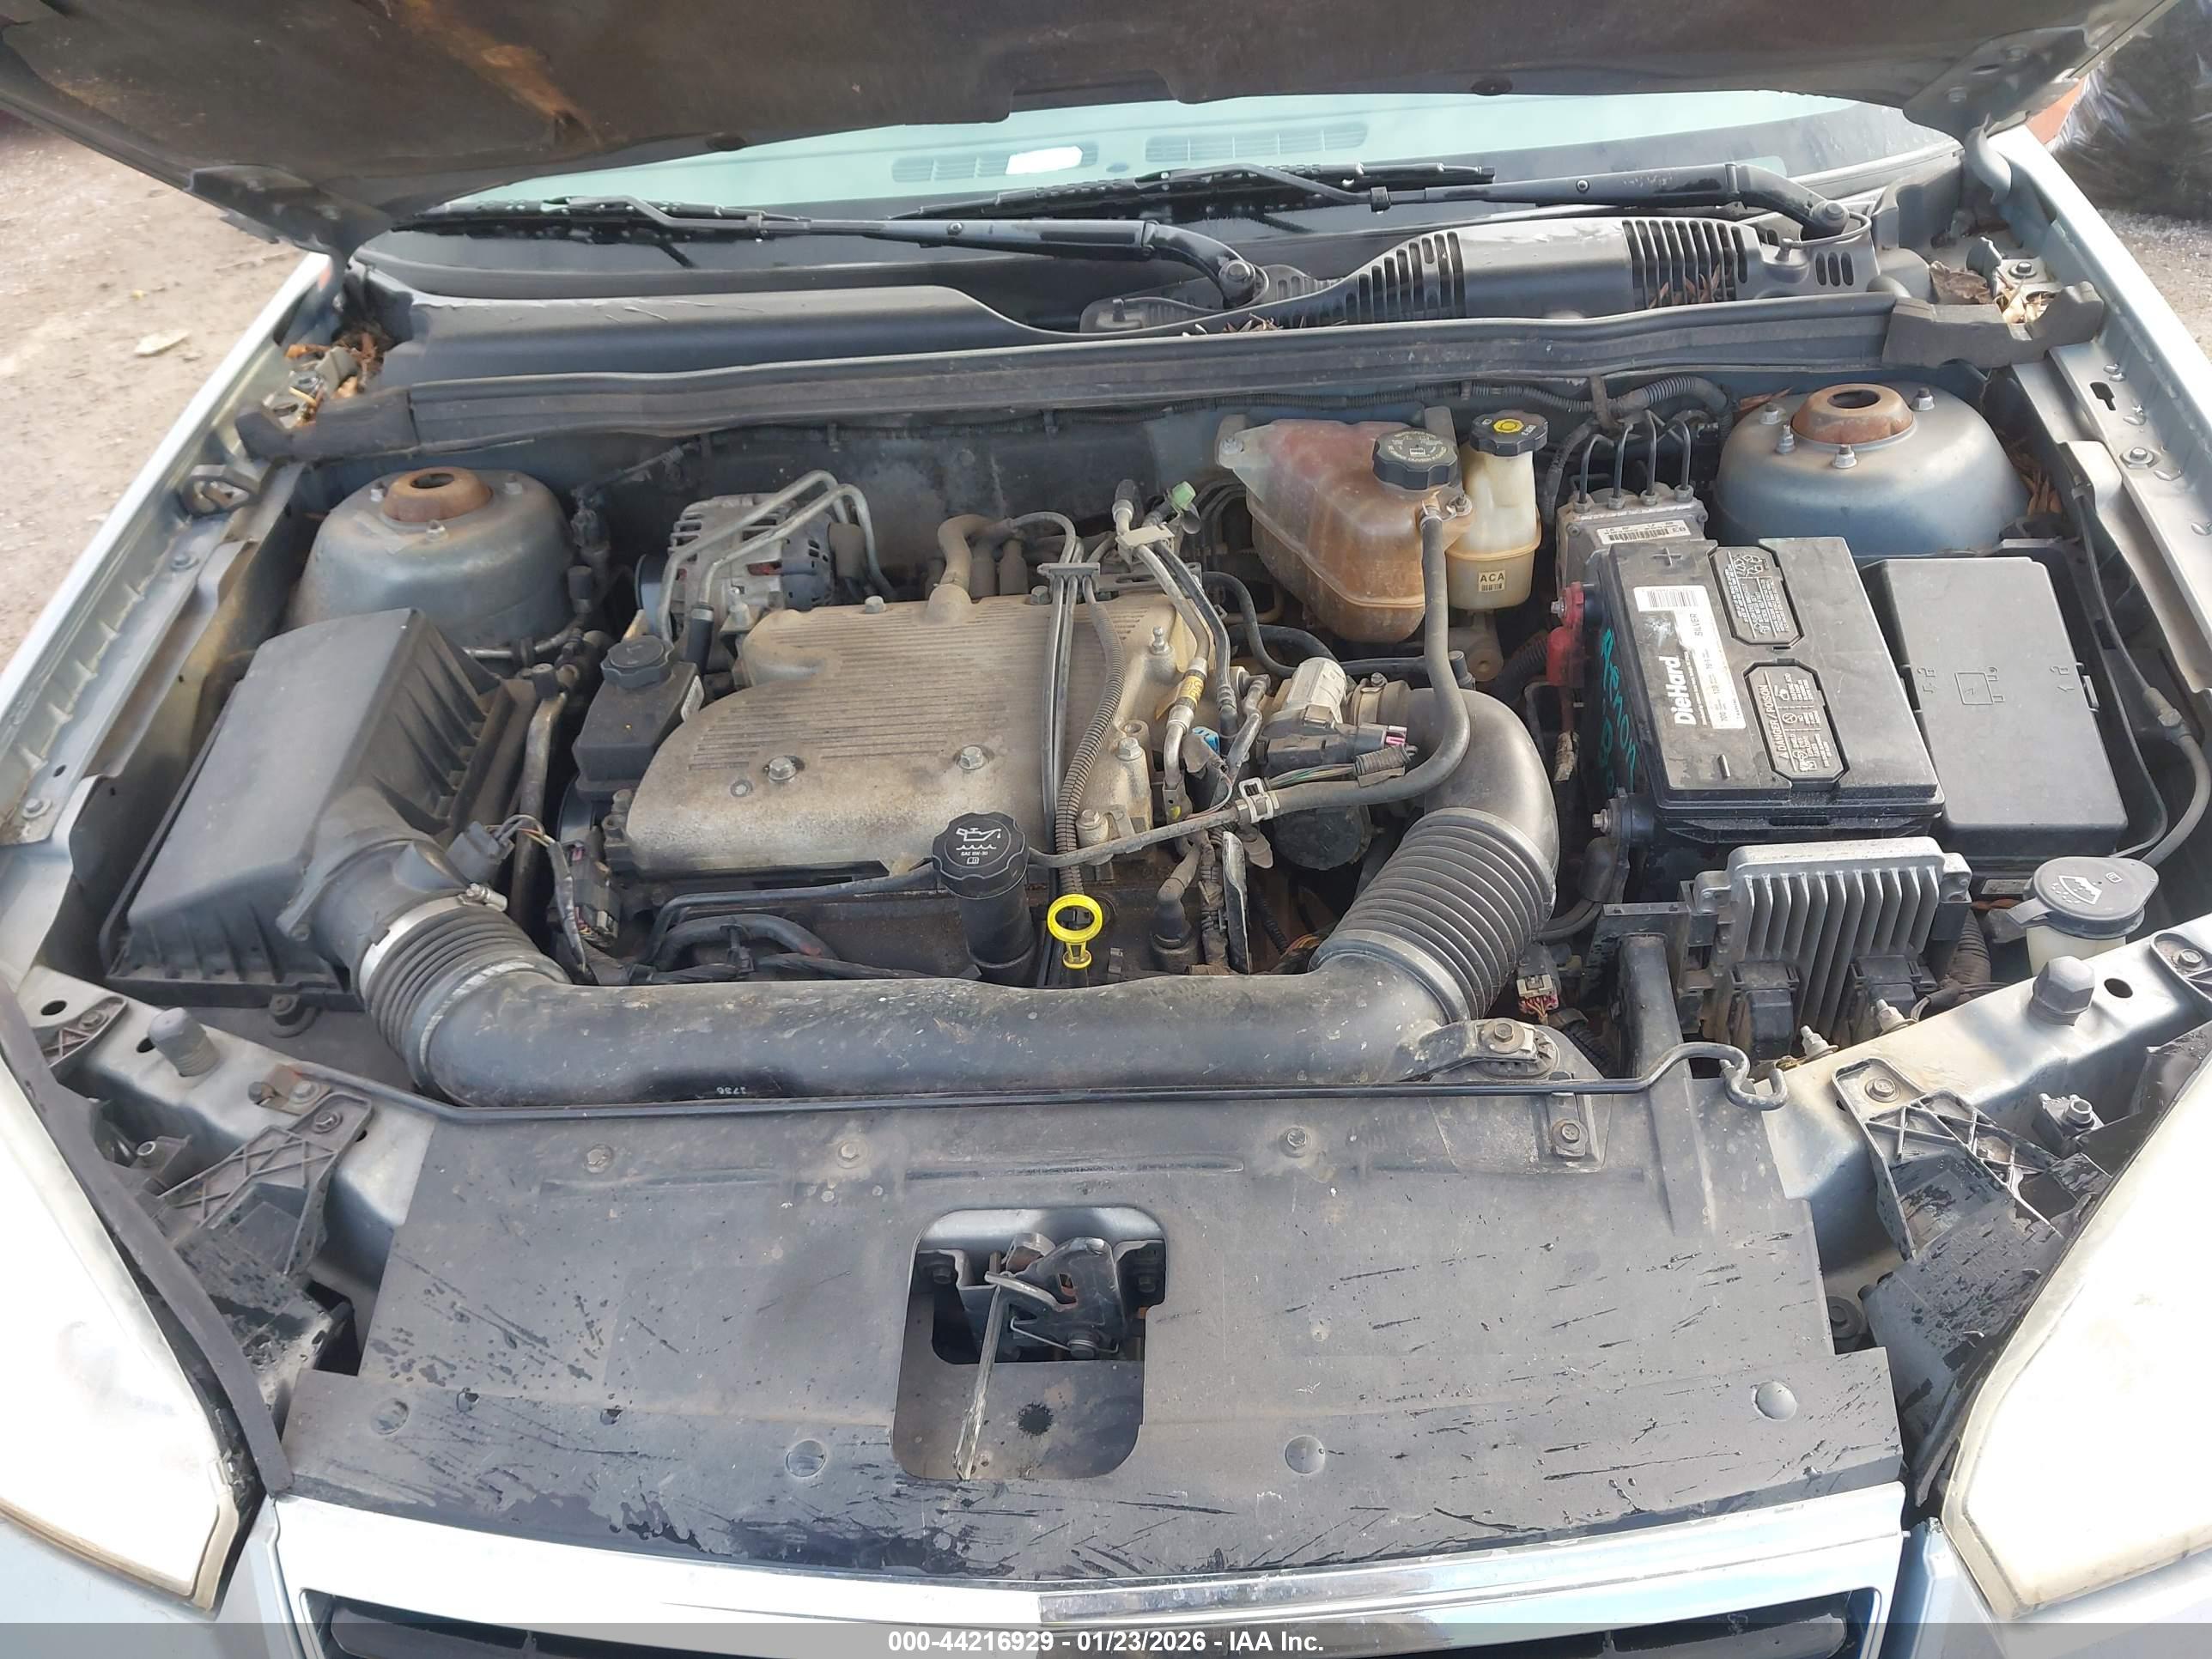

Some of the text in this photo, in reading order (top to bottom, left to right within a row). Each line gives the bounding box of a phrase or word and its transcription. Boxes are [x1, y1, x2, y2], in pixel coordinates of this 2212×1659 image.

[1480, 572, 1505, 582] ACA
[1689, 613, 1704, 636] SILVER
[1658, 655, 1697, 726] DieHard
[1758, 684, 1775, 713] POISON
[1770, 719, 1786, 751] DANGER
